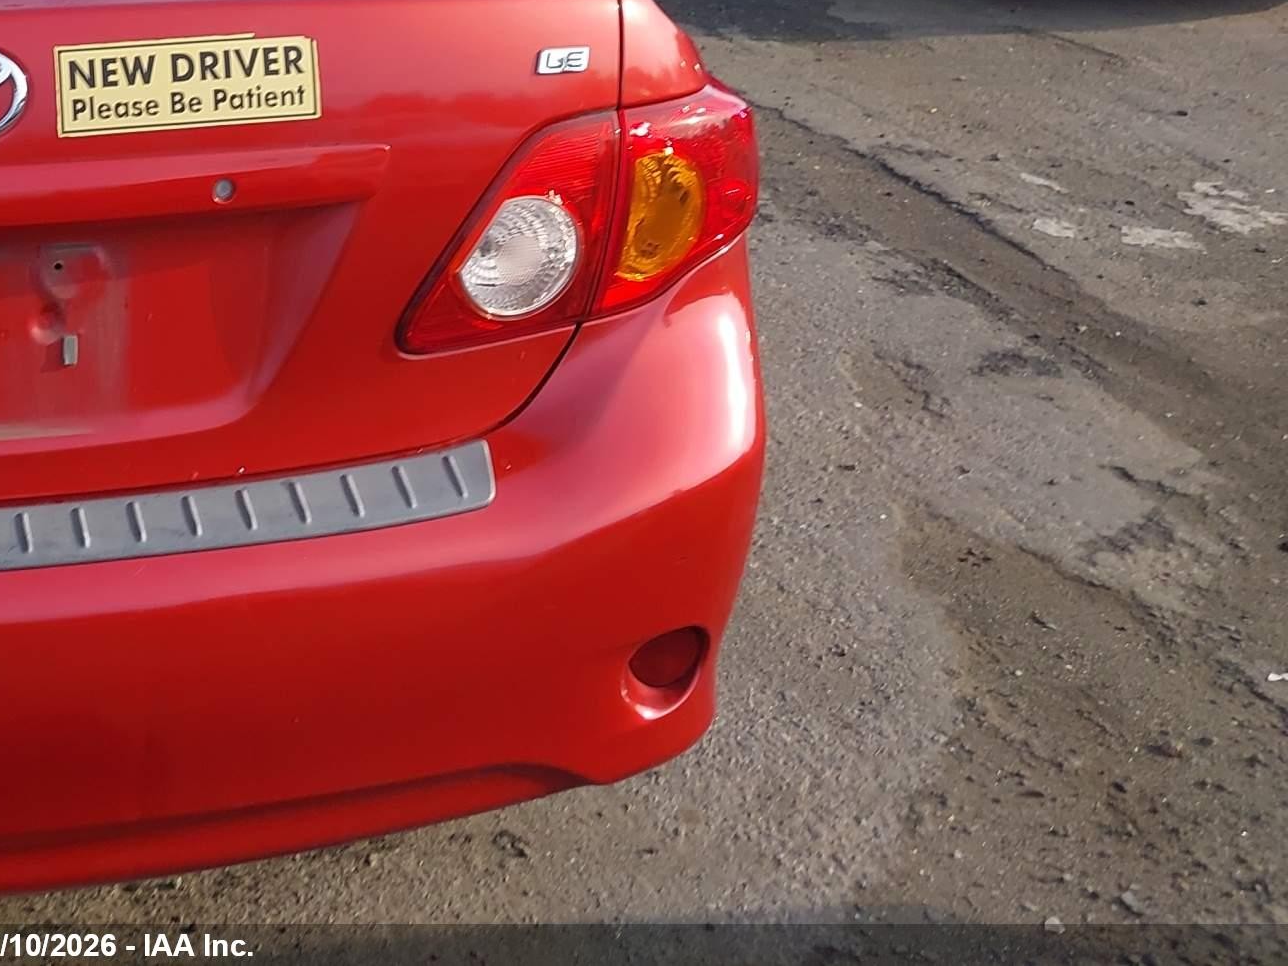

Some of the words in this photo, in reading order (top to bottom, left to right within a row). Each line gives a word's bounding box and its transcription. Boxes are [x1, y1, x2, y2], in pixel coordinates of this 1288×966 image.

[68, 54, 156, 90] NEW
[171, 45, 305, 83] DRIVER
[541, 48, 587, 72] LE
[72, 96, 160, 122] Please
[171, 91, 203, 114] Be
[213, 85, 306, 111] Patient
